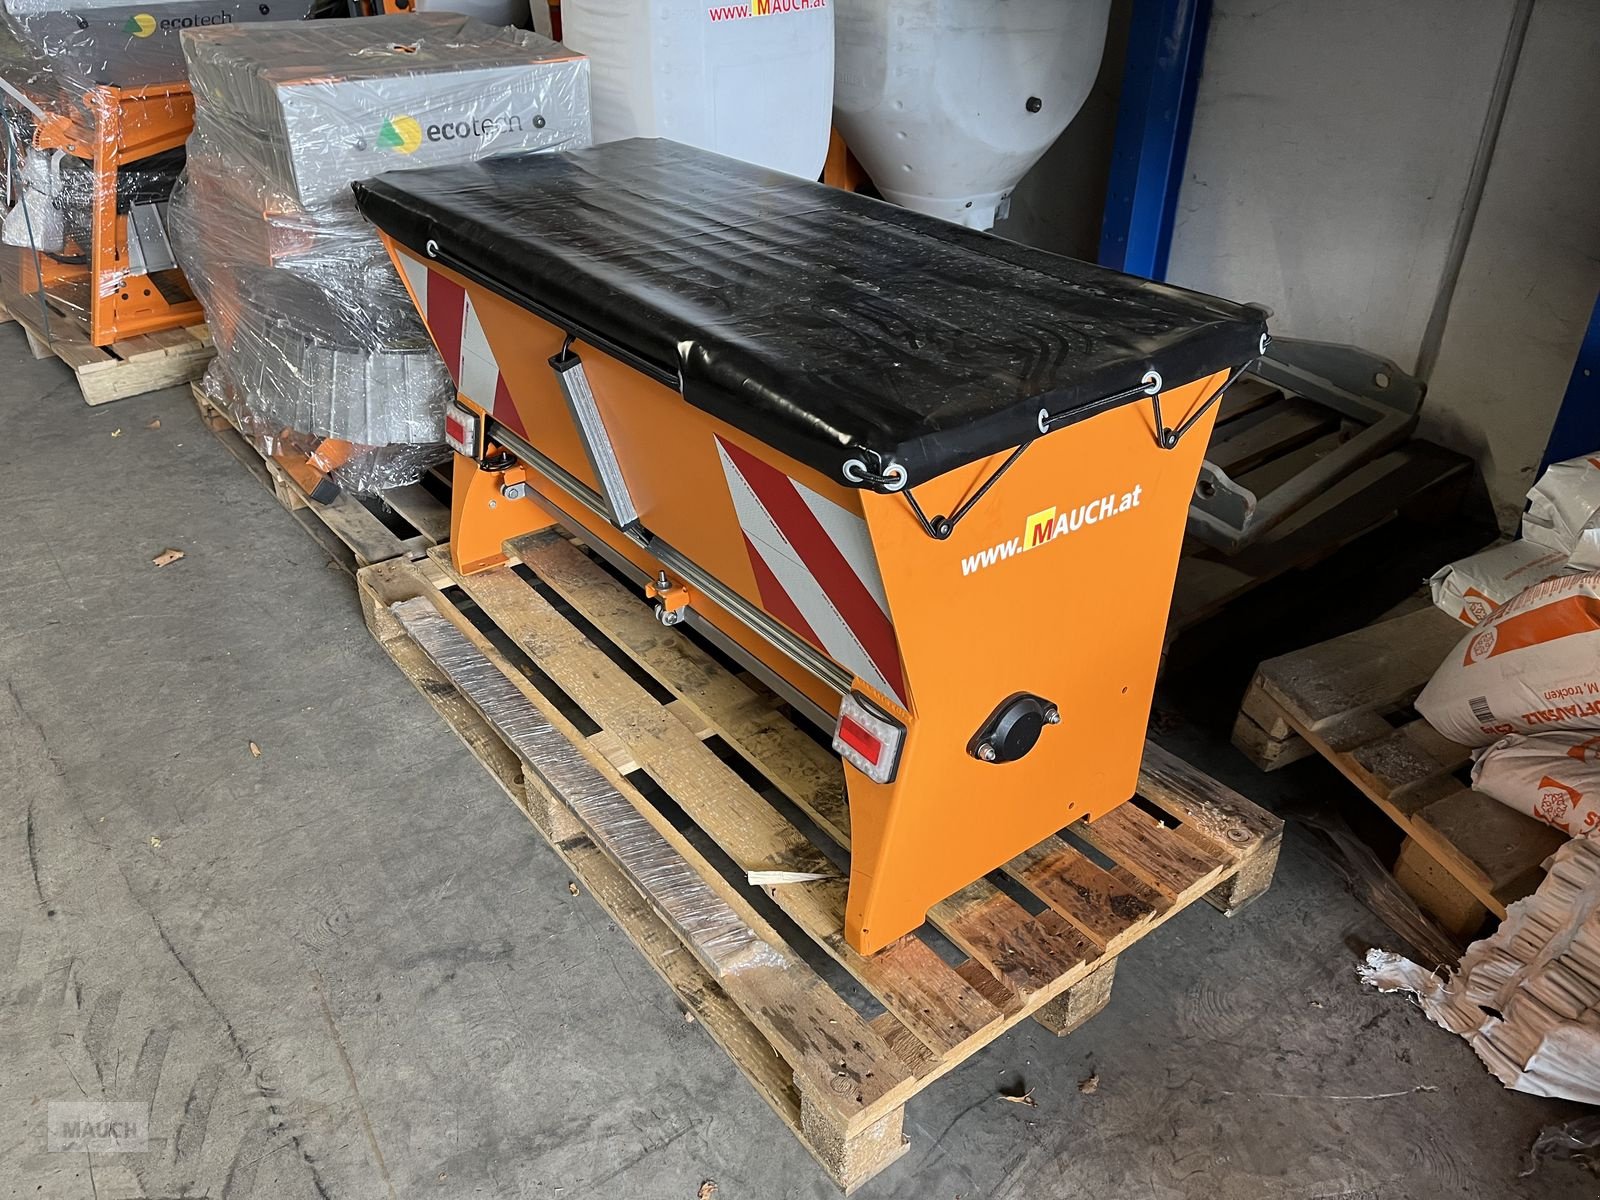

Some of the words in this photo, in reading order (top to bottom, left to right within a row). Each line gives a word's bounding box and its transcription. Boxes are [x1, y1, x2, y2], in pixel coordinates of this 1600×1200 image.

[160, 10, 232, 30] ecotech
[961, 484, 1142, 576] www.MAUCH.at
[1544, 684, 1584, 700] trocken
